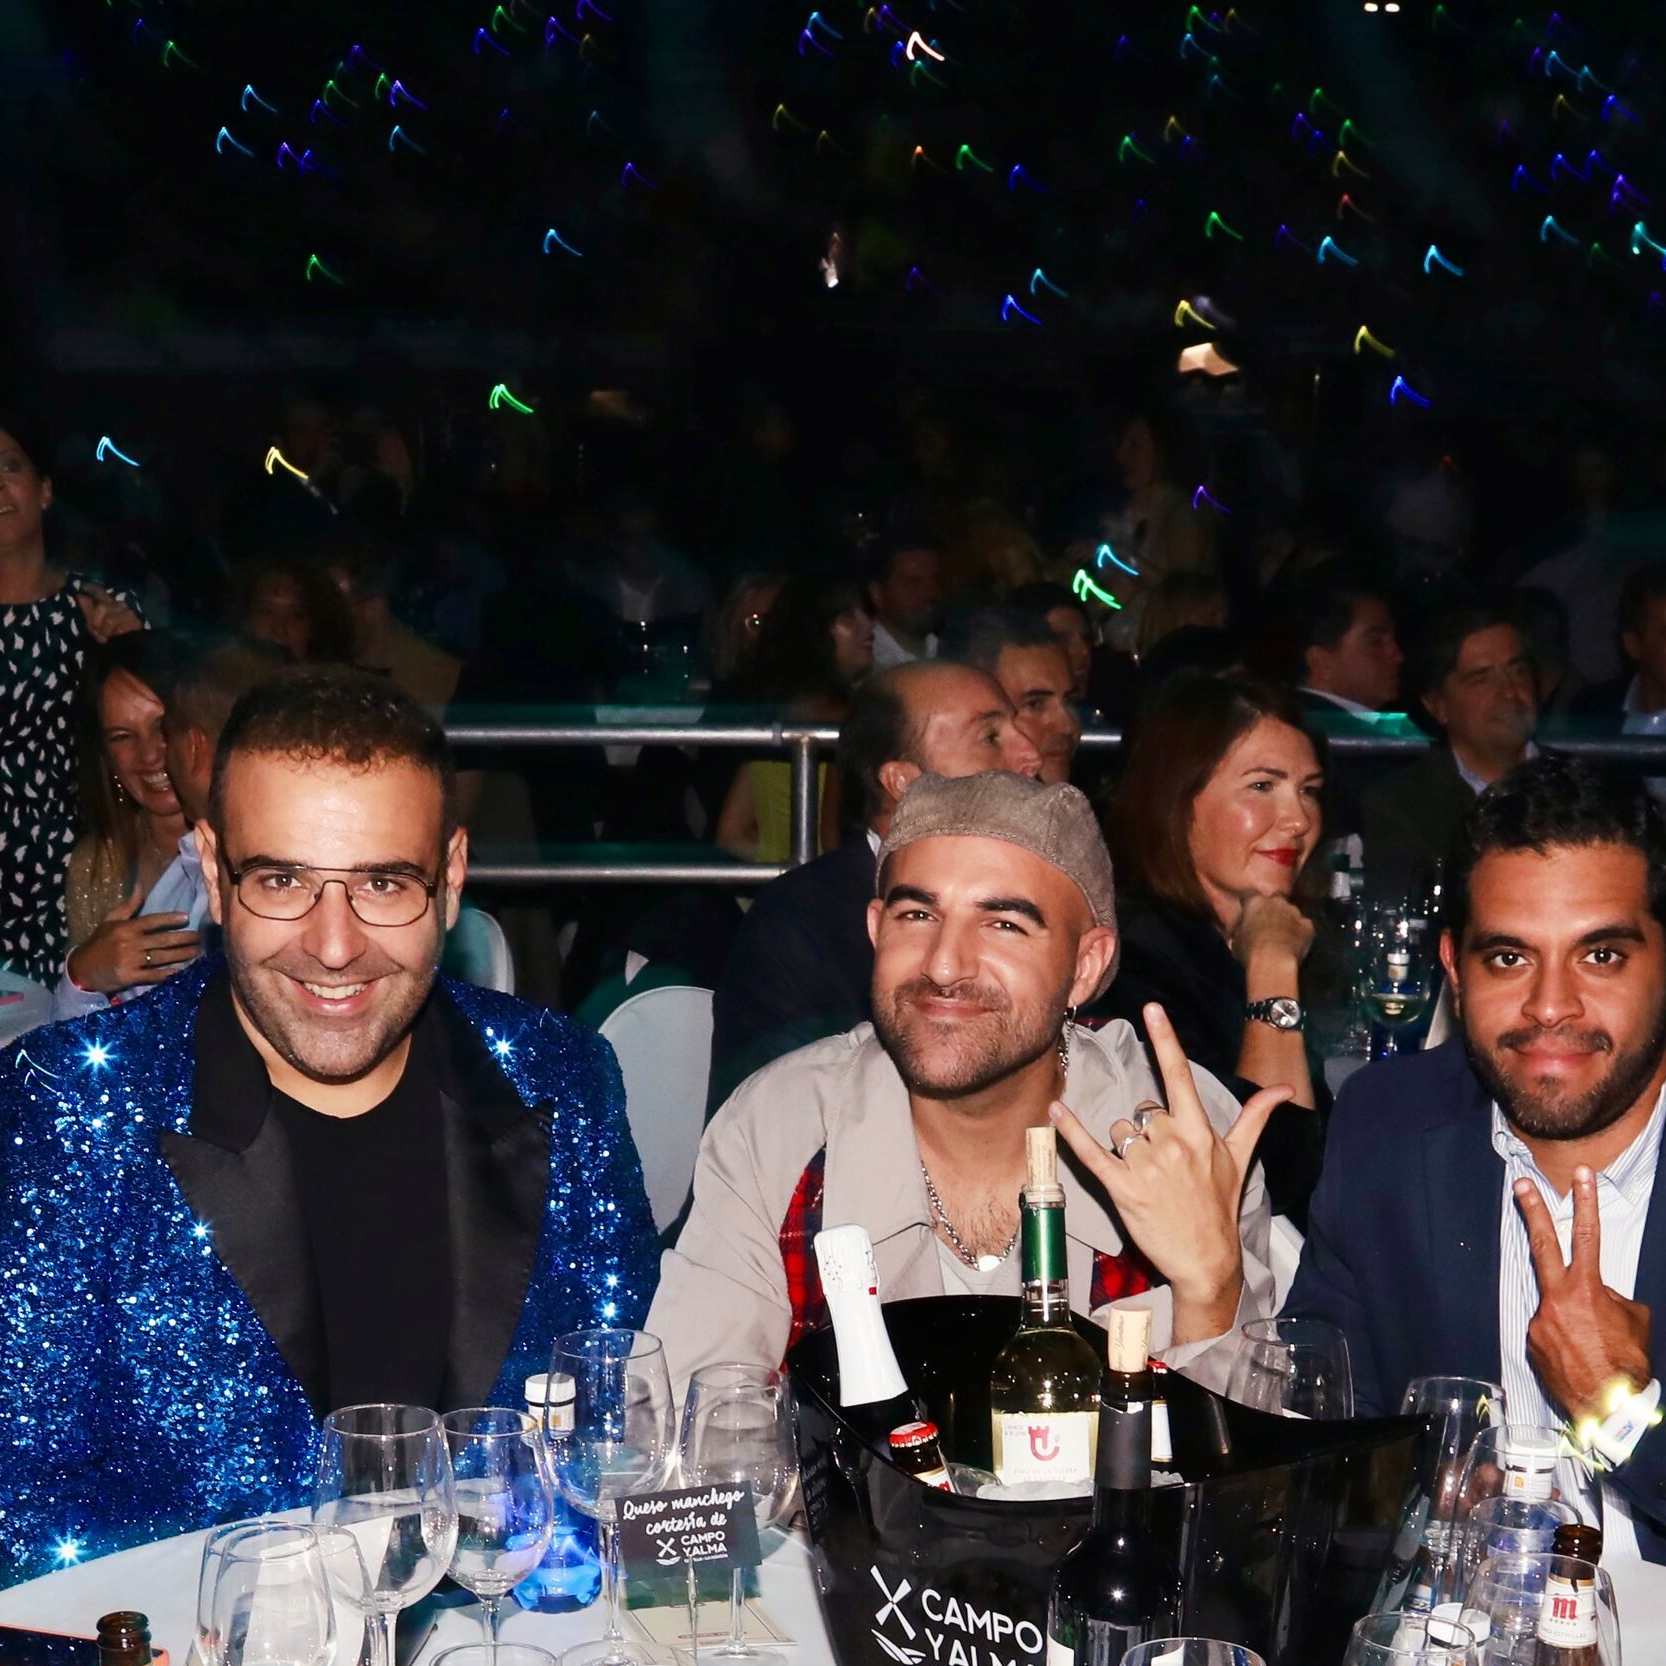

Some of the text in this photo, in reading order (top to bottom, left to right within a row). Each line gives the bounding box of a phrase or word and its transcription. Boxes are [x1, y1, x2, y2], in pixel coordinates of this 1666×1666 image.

[623, 1488, 744, 1520] Queso manchego
[646, 1511, 727, 1535] cortesía de
[681, 1531, 725, 1546] CAMPO
[921, 1588, 1043, 1654] CAMPO
